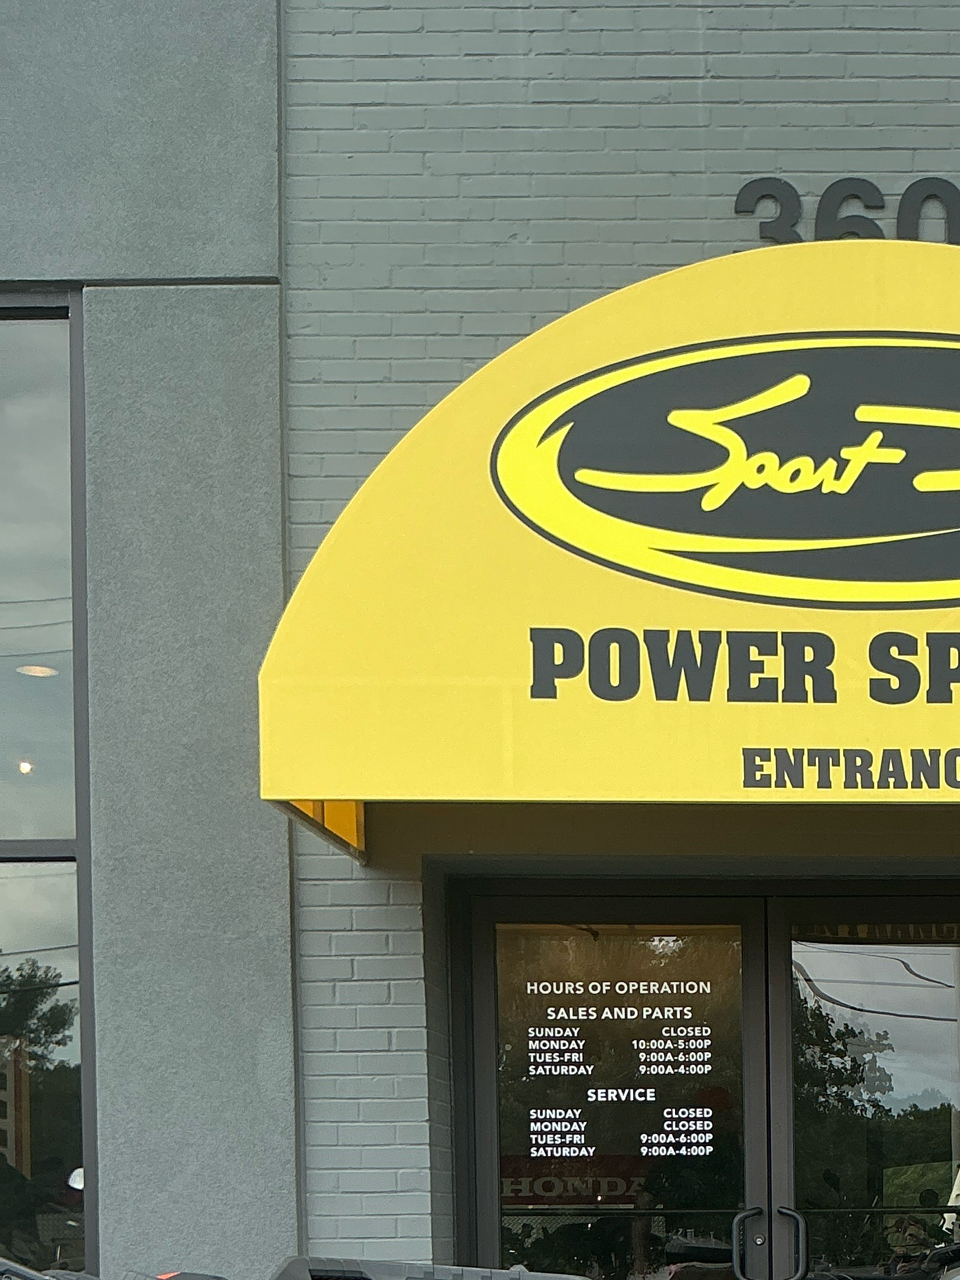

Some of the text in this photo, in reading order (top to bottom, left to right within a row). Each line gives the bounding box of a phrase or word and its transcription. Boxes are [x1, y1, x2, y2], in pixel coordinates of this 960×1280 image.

[574, 374, 906, 512] Sport
[529, 627, 838, 704] POWER
[526, 981, 711, 995] HOURS OF OPERATION
[546, 1006, 693, 1020] SALES AND PARTS
[528, 1026, 712, 1038] SUNDAY CLOSED
[528, 1039, 712, 1050] MONDAY 10:00A-5:00P
[528, 1052, 712, 1063] TUES-FRI 9:00A-6:00P
[528, 1064, 713, 1076] SATURDAY 9:00A-4:00P
[587, 1088, 656, 1102] SERVICE
[529, 1108, 713, 1120] SUNDAY CLOSED
[530, 1120, 713, 1132] MONDAY CLOSED
[530, 1133, 714, 1145] TUES-FRI 9:00A-6:00P
[530, 1145, 714, 1158] SATURDAY 9:00A-4:00P
[501, 1176, 652, 1197] HONDA
